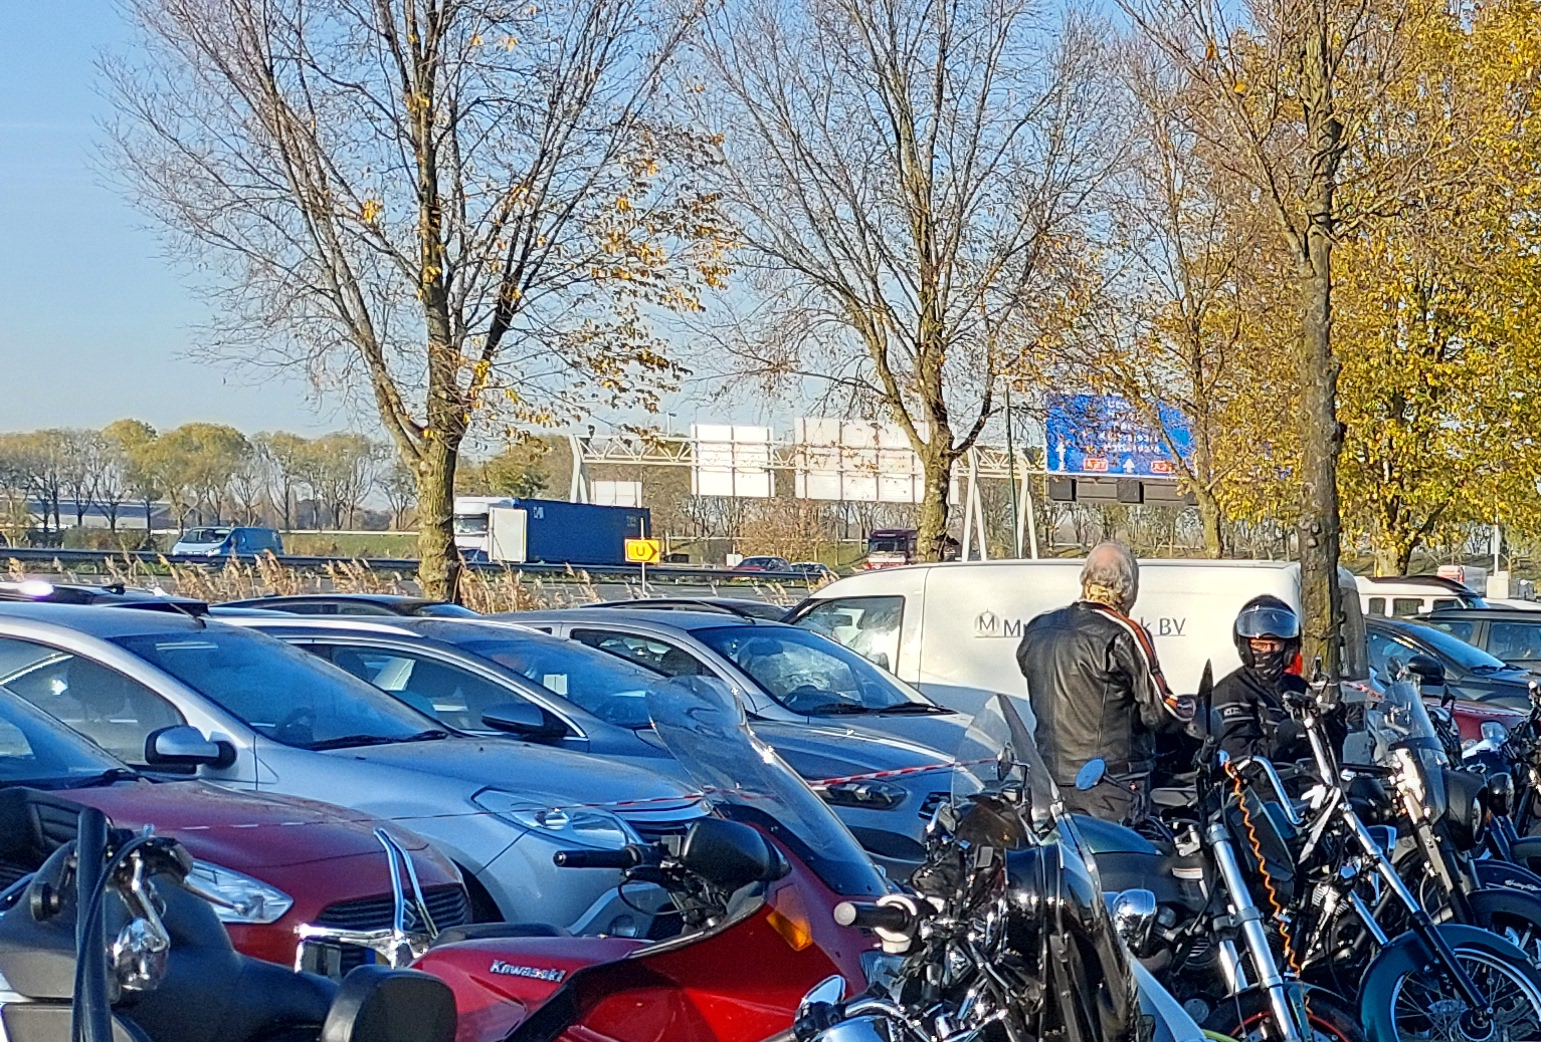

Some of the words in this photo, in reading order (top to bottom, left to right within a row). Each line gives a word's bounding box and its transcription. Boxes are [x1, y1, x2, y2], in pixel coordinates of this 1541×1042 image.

[636, 546, 646, 556] U
[1159, 617, 1187, 636] BV
[490, 960, 567, 983] Kawasaki
